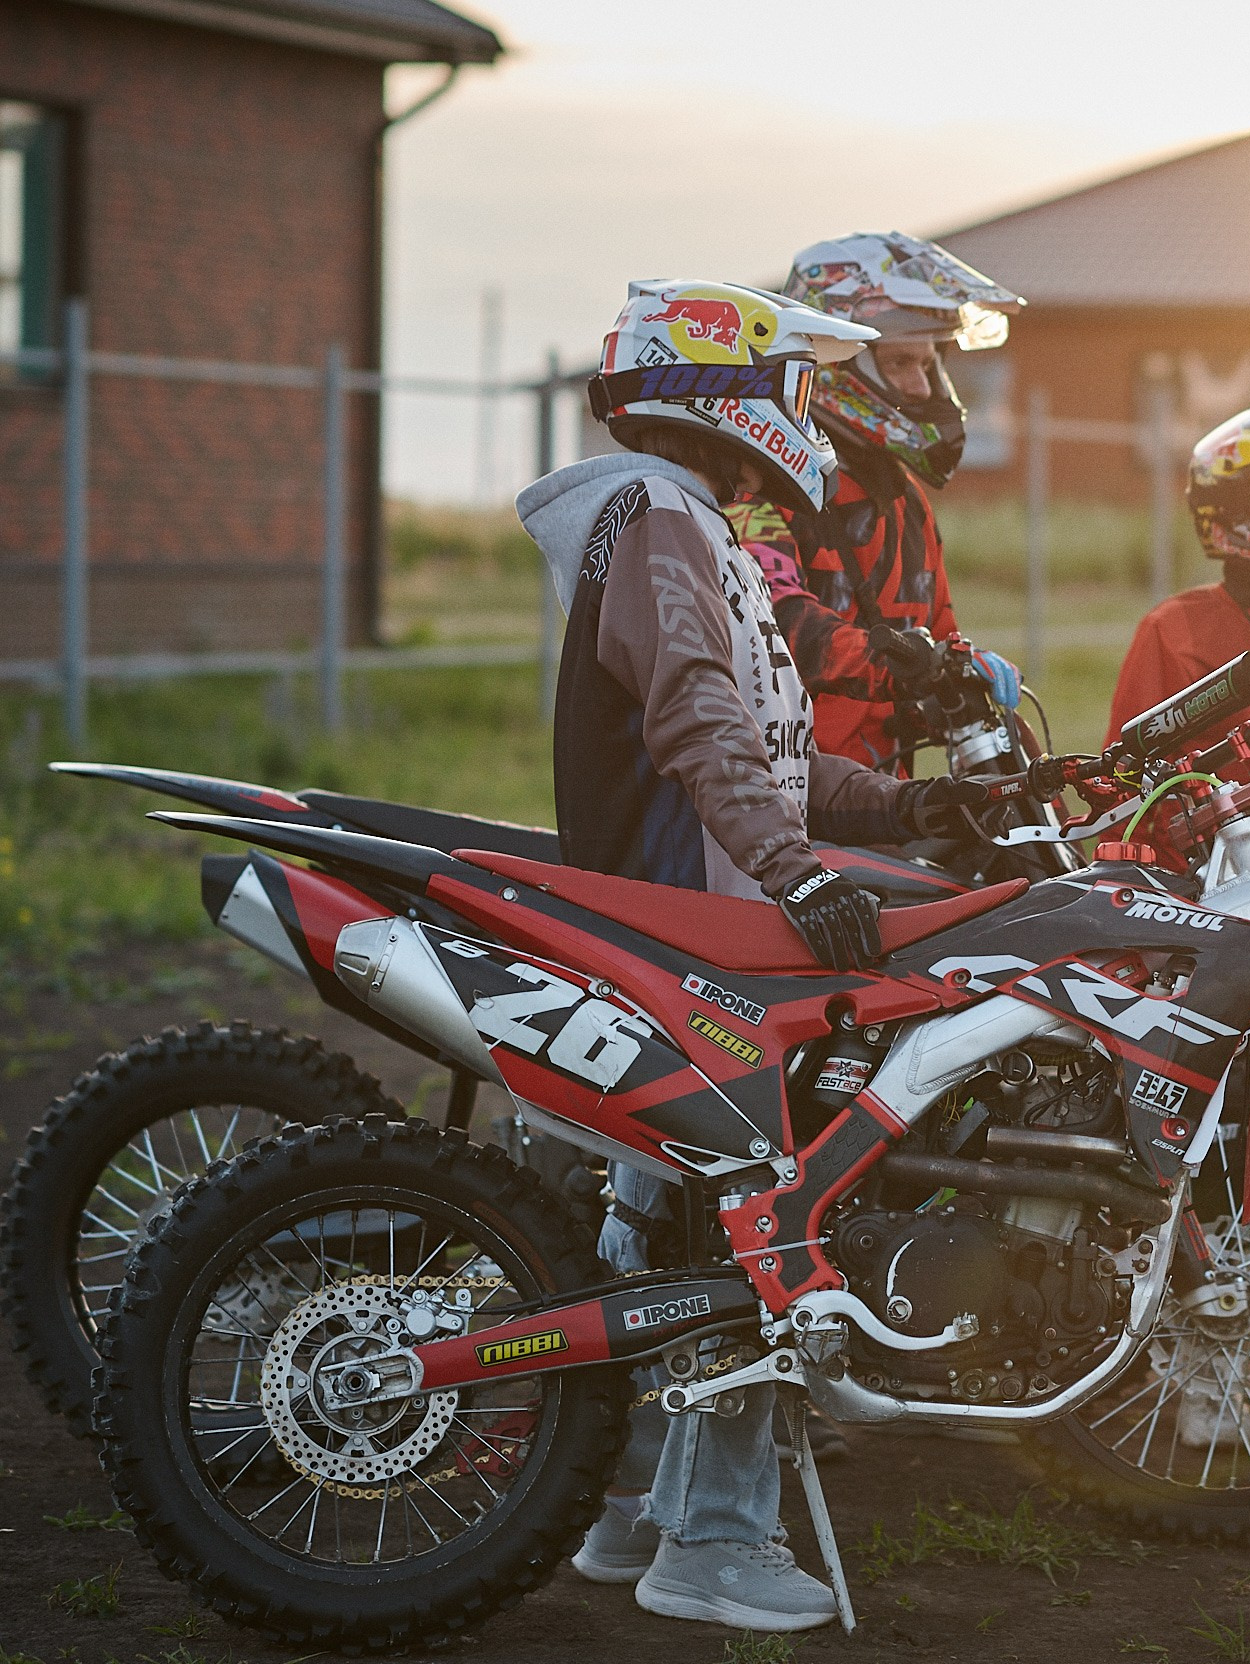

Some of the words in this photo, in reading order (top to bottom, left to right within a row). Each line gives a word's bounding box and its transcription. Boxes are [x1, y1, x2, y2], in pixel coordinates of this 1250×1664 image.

[640, 366, 773, 398] 100%
[717, 397, 772, 442] Red
[765, 428, 809, 475] Bull
[1185, 679, 1230, 720] MOTO
[791, 871, 835, 900] 100%
[1124, 901, 1226, 932] MOTUL
[699, 984, 766, 1025] IPONE
[468, 962, 642, 1088] 26
[643, 1295, 711, 1325] IPONE
